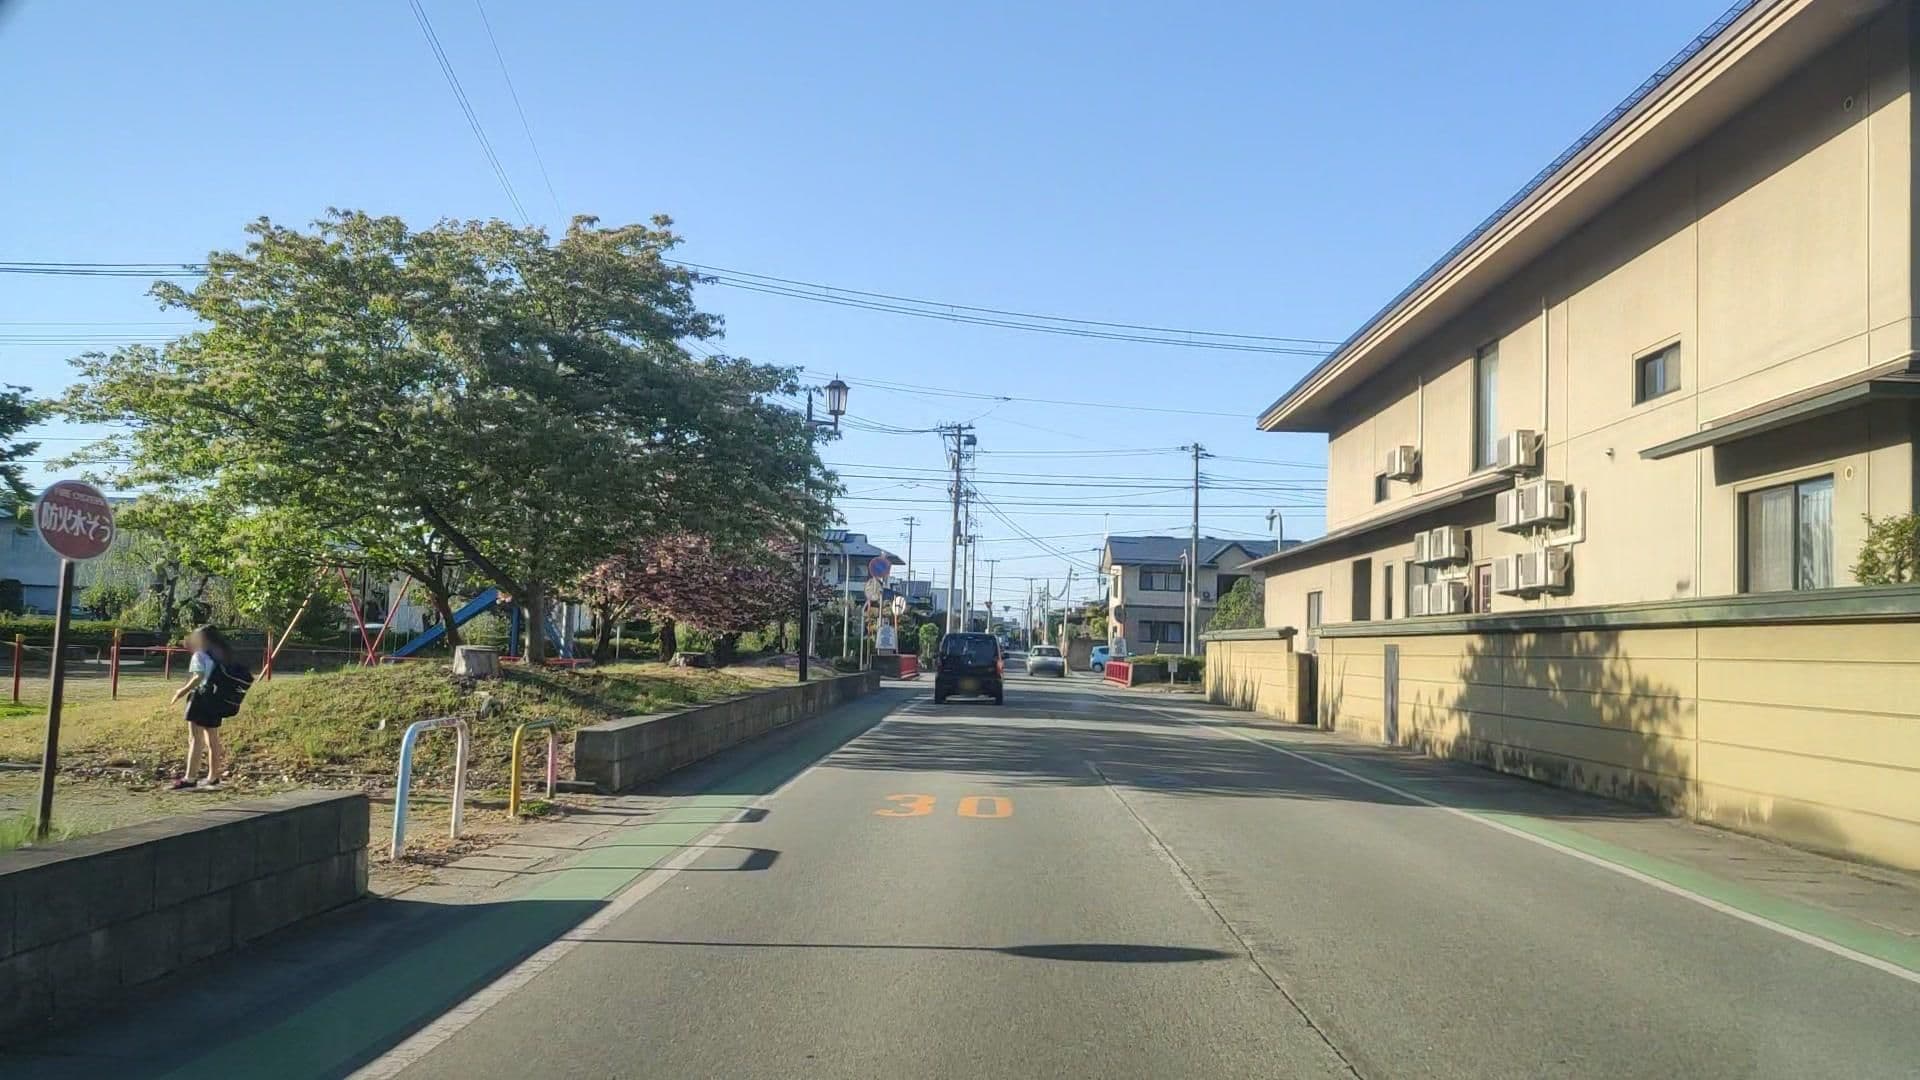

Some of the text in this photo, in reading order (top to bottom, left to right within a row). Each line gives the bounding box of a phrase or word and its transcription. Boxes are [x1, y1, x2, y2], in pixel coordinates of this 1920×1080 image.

[41, 502, 111, 542] 防火水そう
[873, 793, 1014, 818] 30
